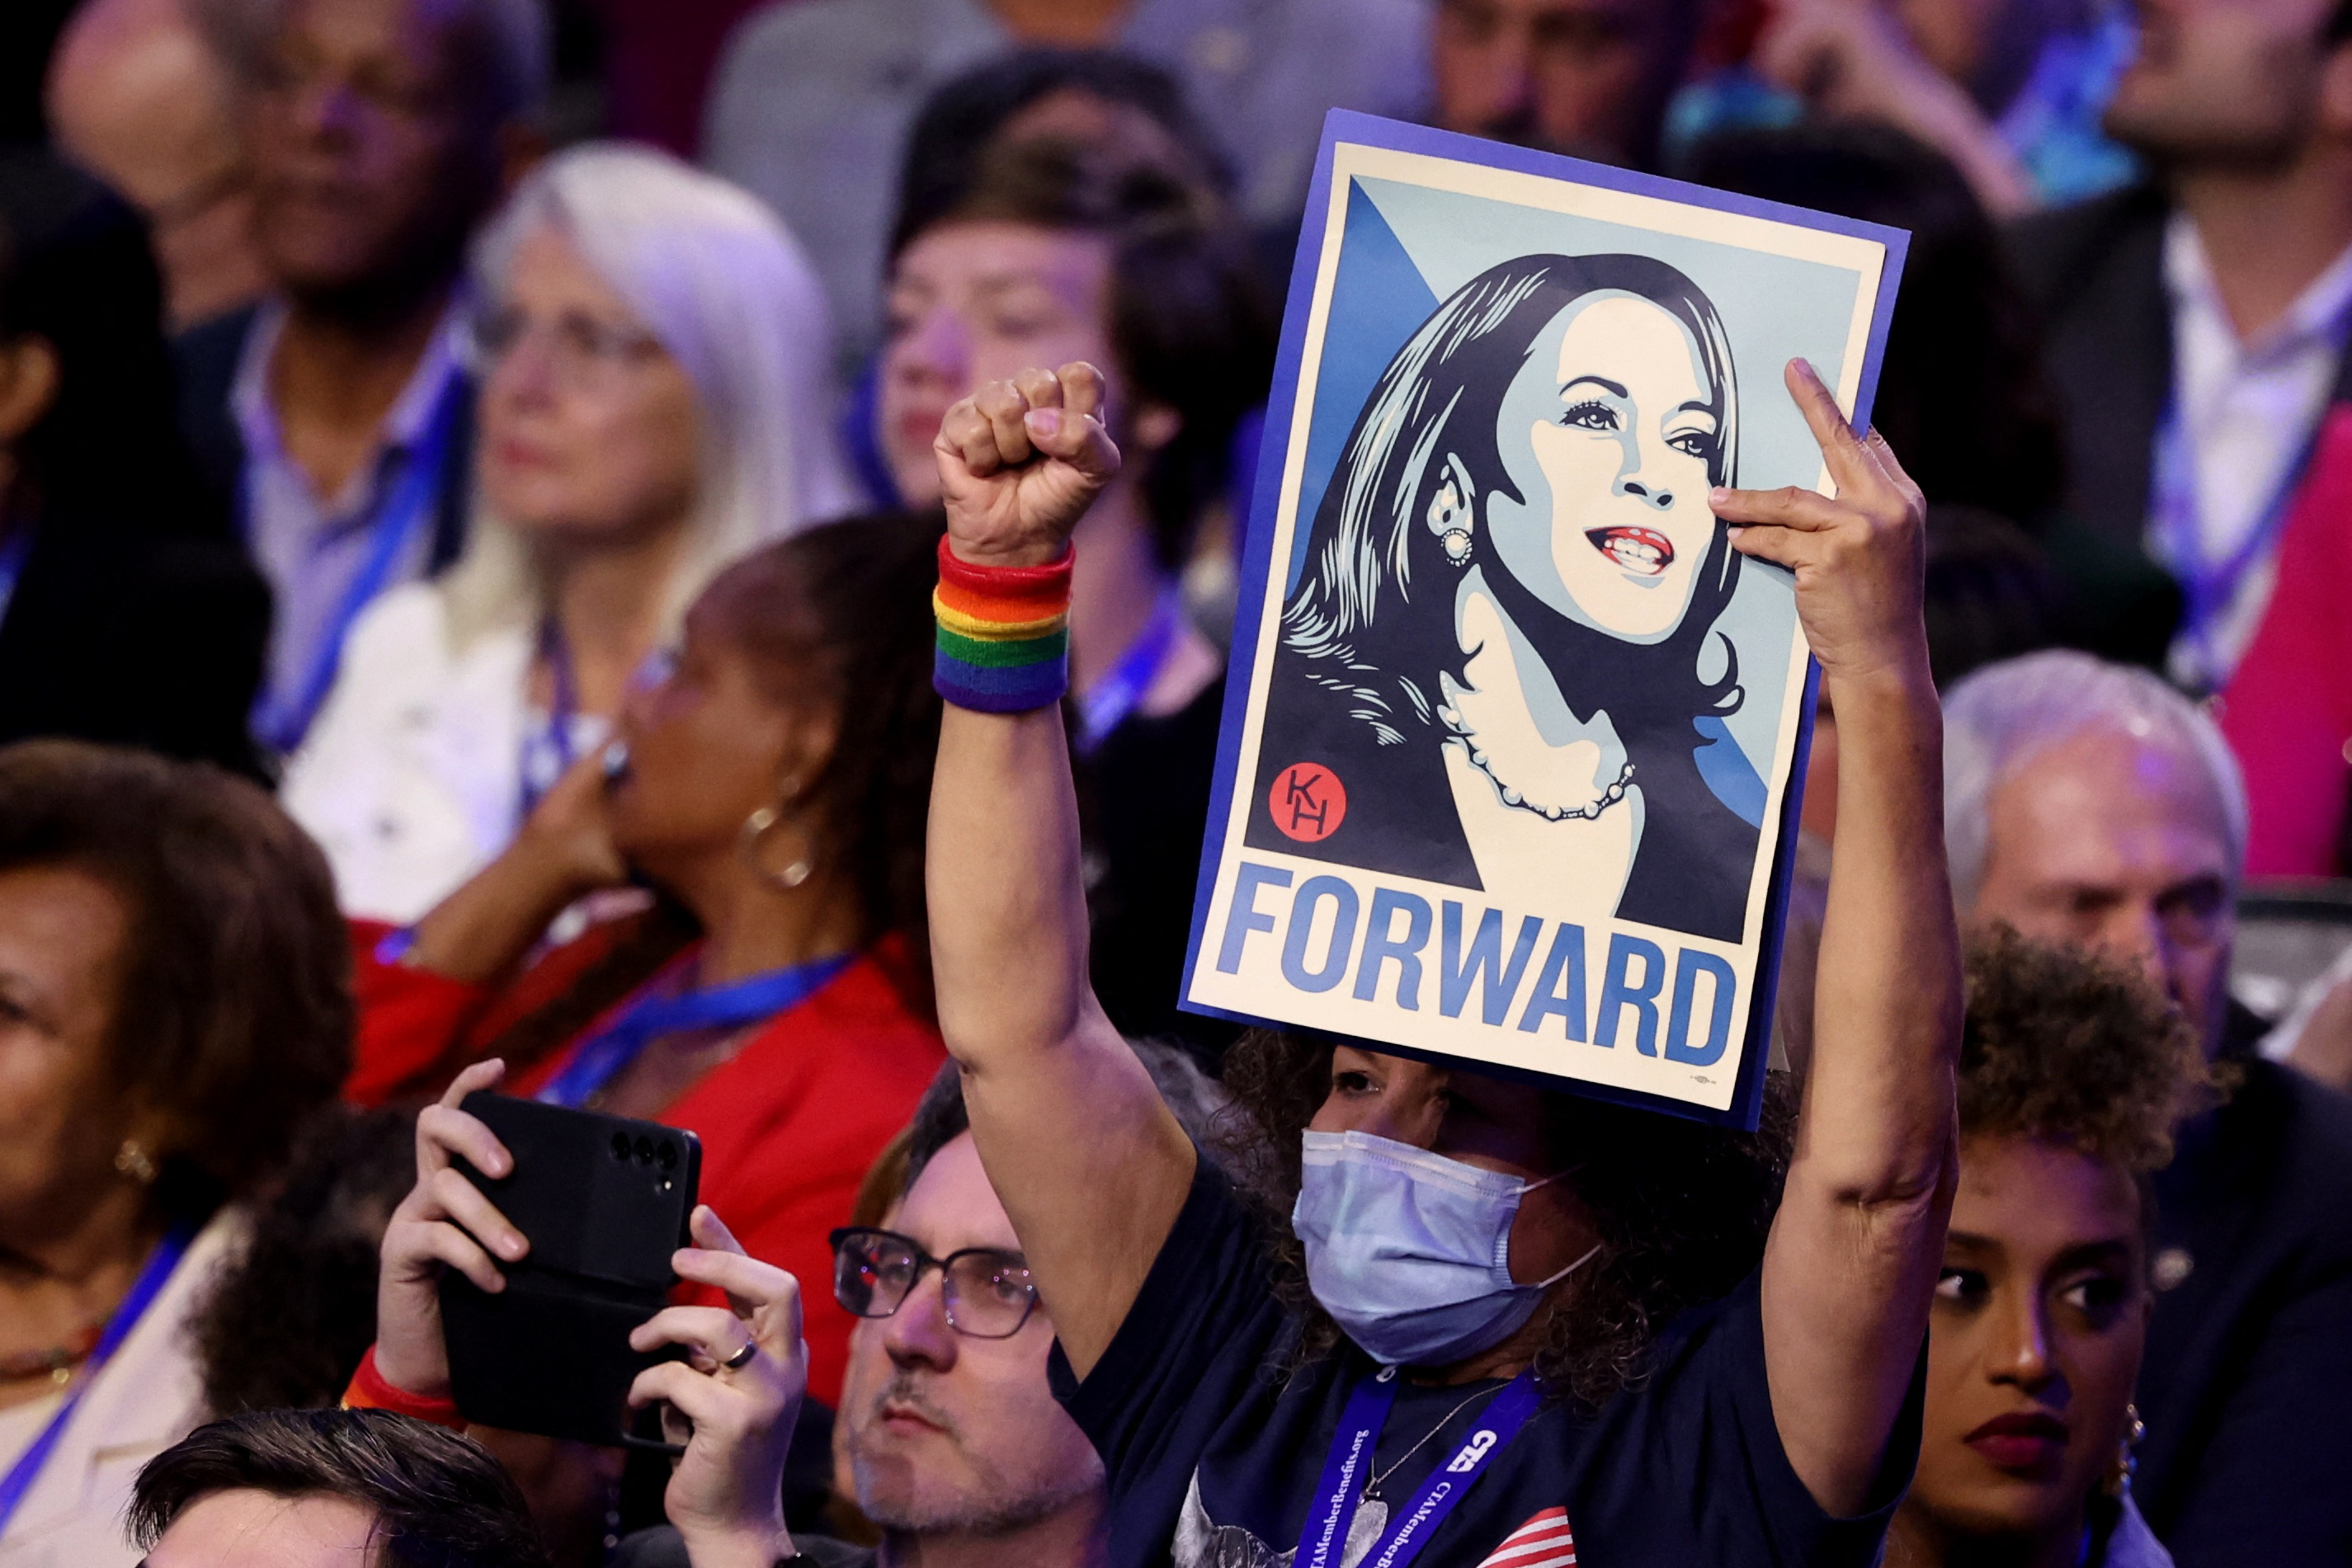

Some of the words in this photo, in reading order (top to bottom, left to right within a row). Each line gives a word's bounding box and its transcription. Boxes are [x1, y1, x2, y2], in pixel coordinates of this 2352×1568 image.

[1286, 770, 1327, 835] KH
[1216, 861, 1737, 1067] FORWARD
[1445, 1429, 1497, 1472] CTA
[1374, 1481, 1452, 1568] CTAMemberB
